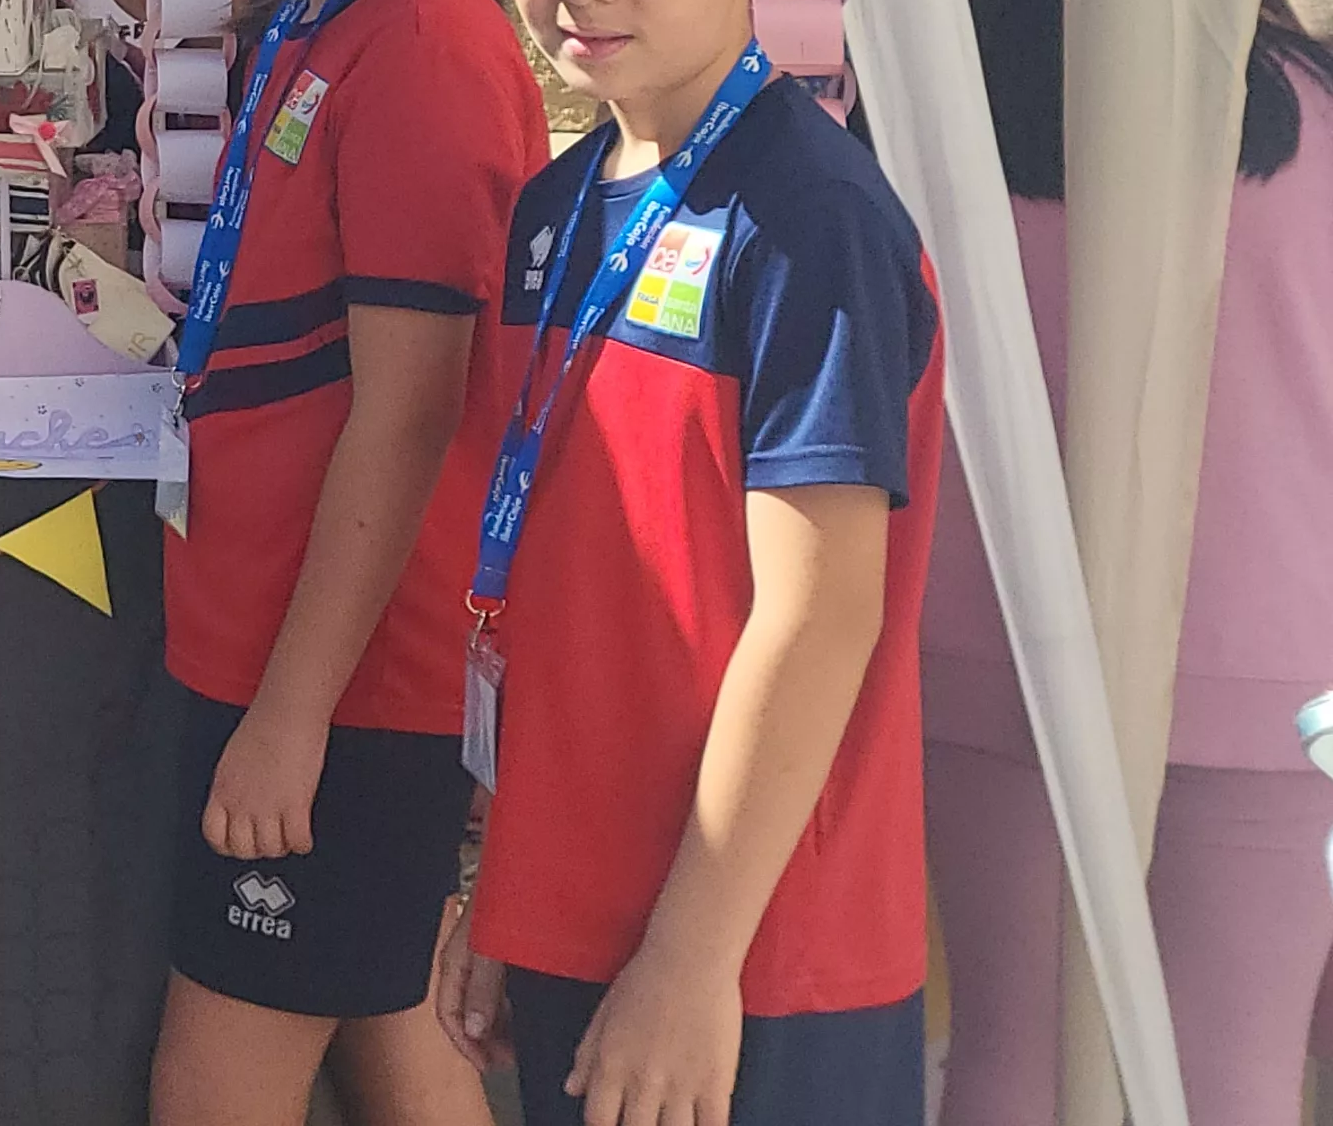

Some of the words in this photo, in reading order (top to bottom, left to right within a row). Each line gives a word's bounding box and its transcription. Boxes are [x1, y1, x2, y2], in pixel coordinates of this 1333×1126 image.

[649, 244, 678, 273] ce
[659, 313, 696, 334] ANA
[227, 902, 293, 941] errea
